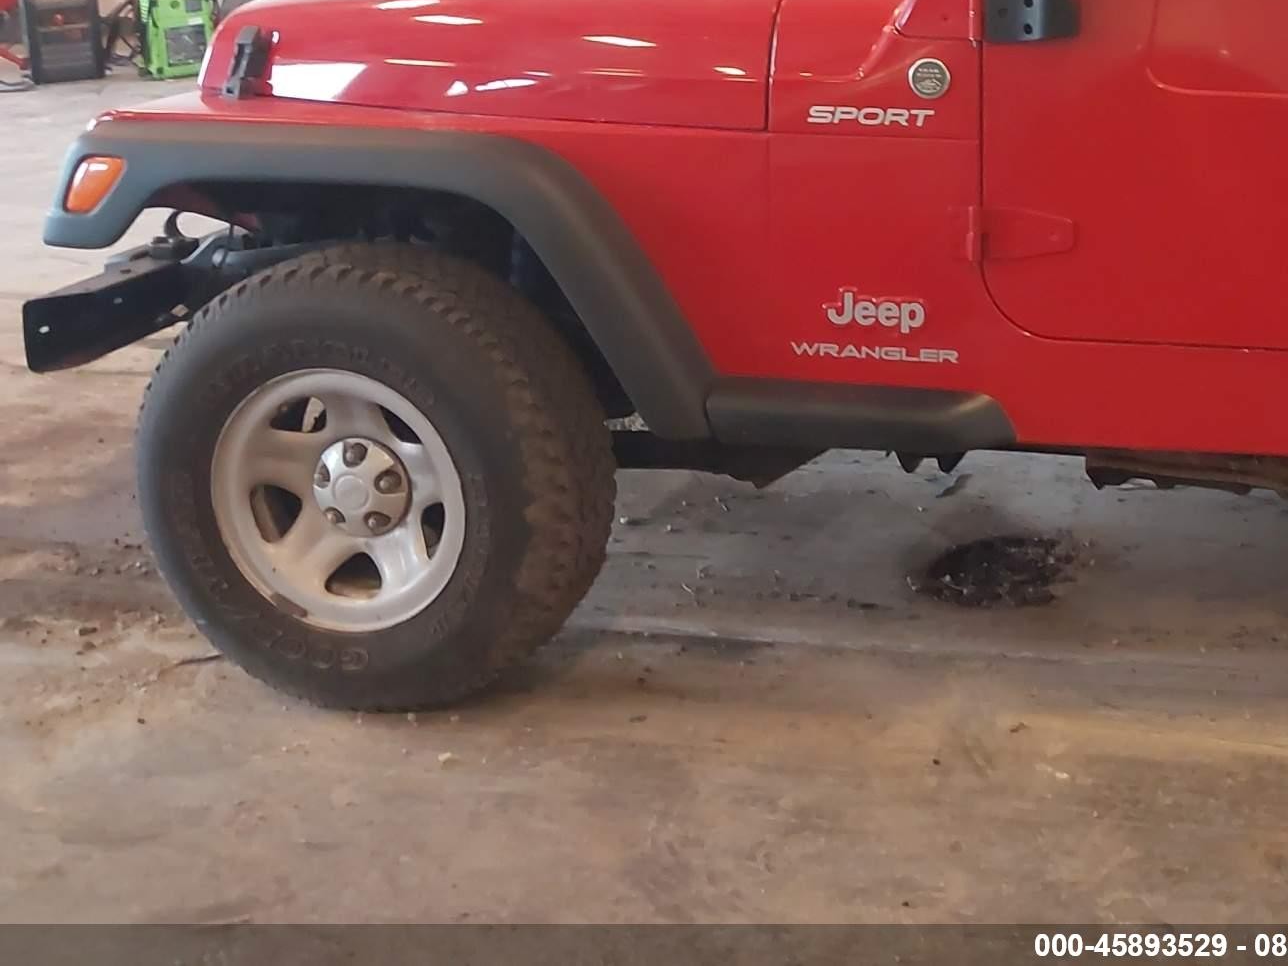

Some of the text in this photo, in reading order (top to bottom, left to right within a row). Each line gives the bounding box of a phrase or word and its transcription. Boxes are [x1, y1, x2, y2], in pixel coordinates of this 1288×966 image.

[807, 105, 935, 127] SPORT
[826, 291, 925, 334] Jeep
[790, 341, 959, 364] WRANGLER
